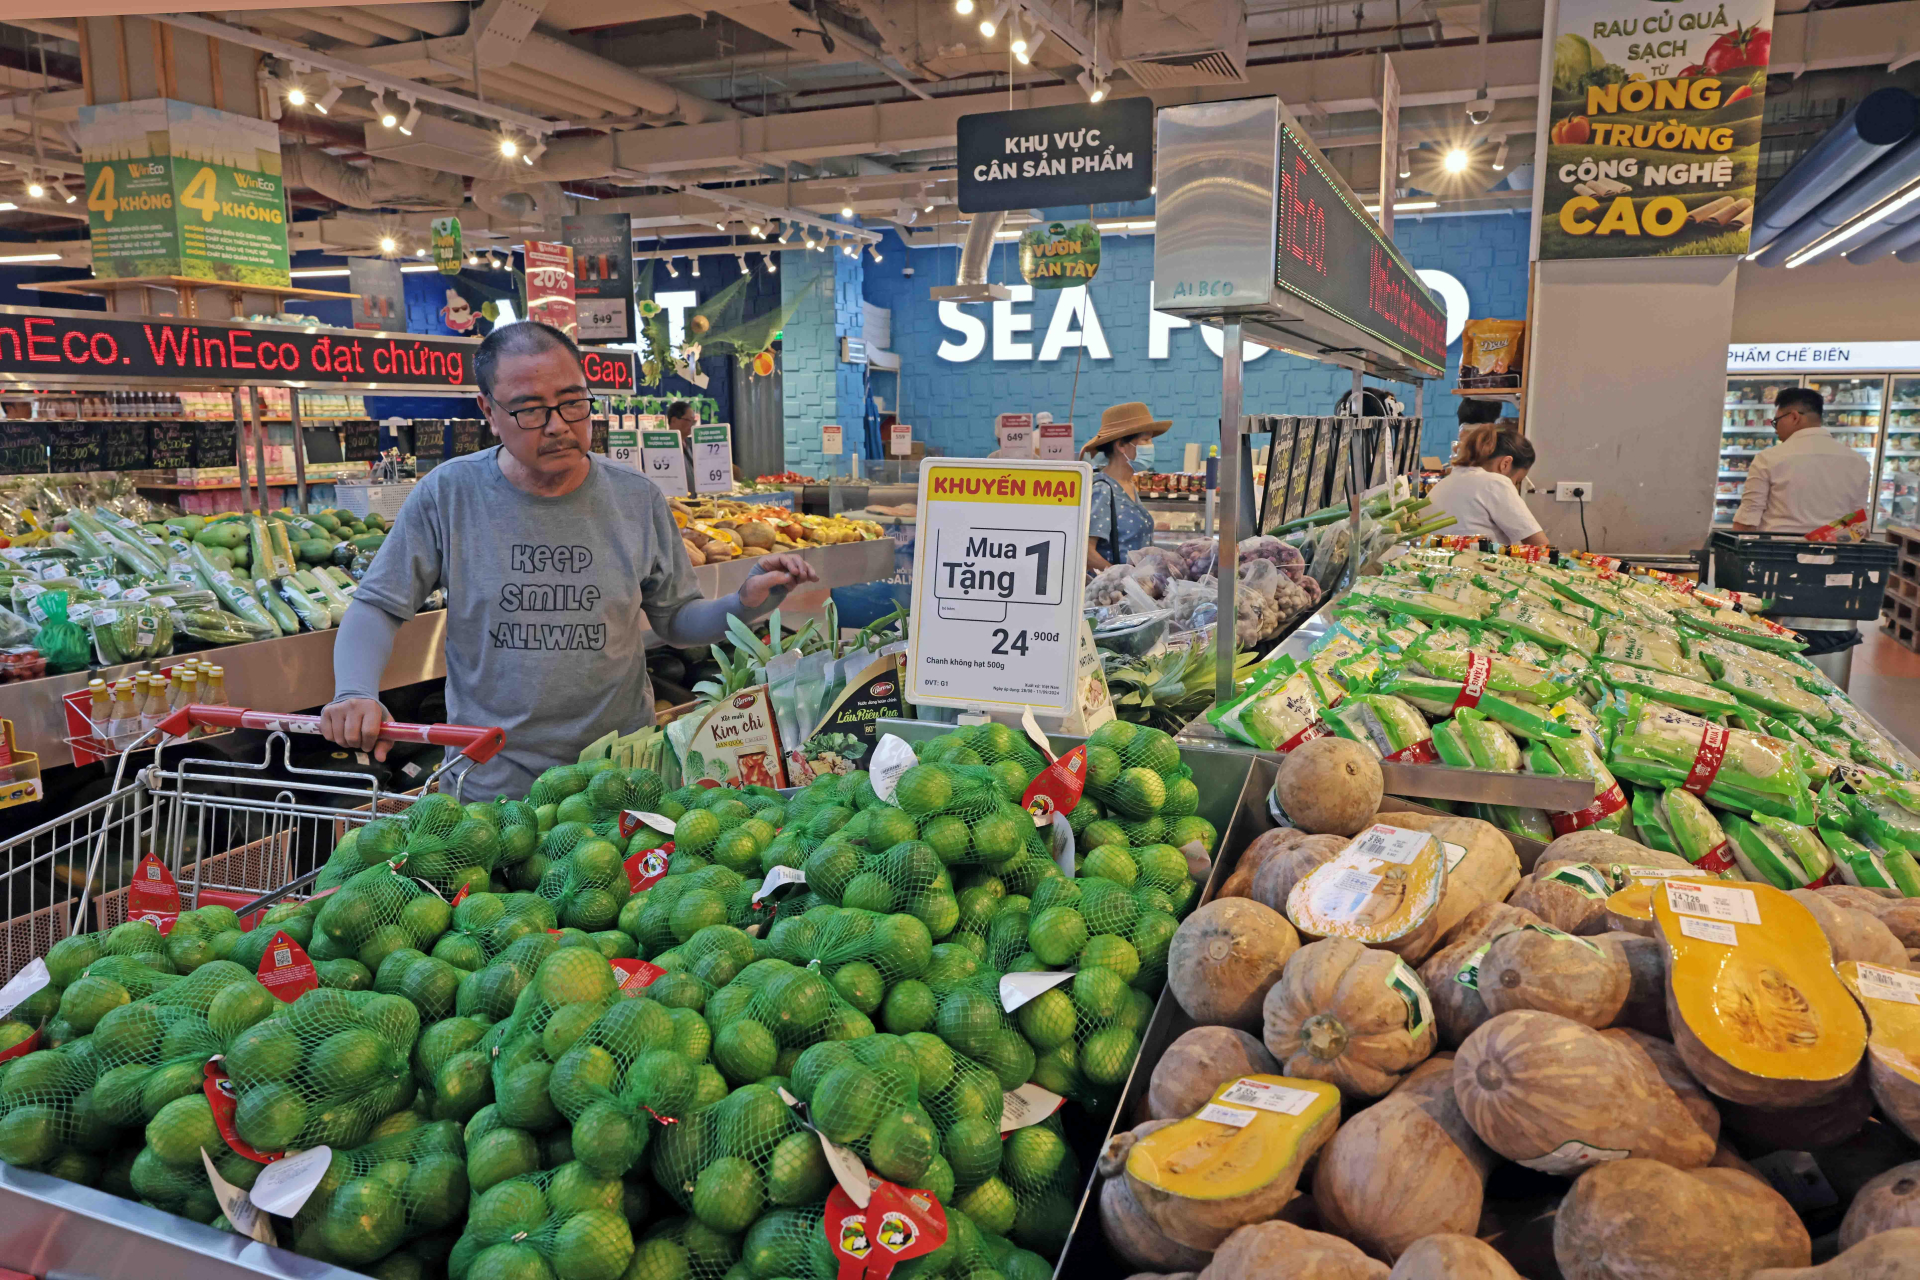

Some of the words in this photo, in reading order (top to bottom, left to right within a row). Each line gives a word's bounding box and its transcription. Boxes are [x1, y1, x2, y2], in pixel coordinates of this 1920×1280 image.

[1593, 19, 1638, 39] RAU
[1643, 9, 1674, 34] CỦ
[1678, 4, 1728, 31] QUẢ
[1627, 39, 1687, 63] SẠCH
[1651, 63, 1669, 77] TỪ
[1587, 72, 1722, 116] NÔNG
[1005, 134, 1048, 155] KHU
[1053, 128, 1100, 151] VỰC
[1591, 119, 1734, 152] TRƯỜNG
[973, 158, 1017, 182] CÂN
[1022, 151, 1067, 177] SẢN
[1072, 145, 1134, 174] PHẨM
[1559, 157, 1638, 183] CÔNG
[1644, 155, 1733, 187] NGHỆ
[88, 166, 118, 222] 4
[120, 191, 172, 211] KHÔNG
[233, 172, 275, 191] WinEco
[180, 167, 220, 222] 4
[222, 201, 282, 224] KHÔNG
[1559, 196, 1688, 237] CAO
[1032, 238, 1081, 257] VƯỜN
[533, 270, 568, 290] 20%
[1064, 259, 1097, 278] TÂY
[937, 281, 1114, 362] SEA
[143, 324, 300, 370] WinEco
[311, 335, 364, 382] đạt
[373, 341, 463, 385] chứng
[580, 352, 633, 389] Gap,
[1776, 347, 1811, 362] CHẾ
[1813, 347, 1850, 362] BIẾN
[707, 444, 720, 455] 72
[1007, 433, 1023, 441] 649
[616, 448, 630, 460] 69
[709, 469, 722, 481] 69
[934, 474, 1026, 497] KHUYẾN
[1033, 480, 1076, 502] MẠI
[966, 537, 1017, 559] Mua
[943, 562, 1015, 598] Tặng
[1025, 540, 1050, 596] 1
[991, 628, 1029, 657] 24
[926, 656, 949, 665] Chanh
[950, 658, 972, 668] không
[973, 660, 985, 669] hạt
[987, 661, 1005, 670] 500g
[711, 724, 739, 741] Kim
[742, 713, 764, 732] chi
[836, 709, 857, 723] Lẩu
[857, 708, 879, 721] Riêu
[880, 706, 898, 717] Cua
